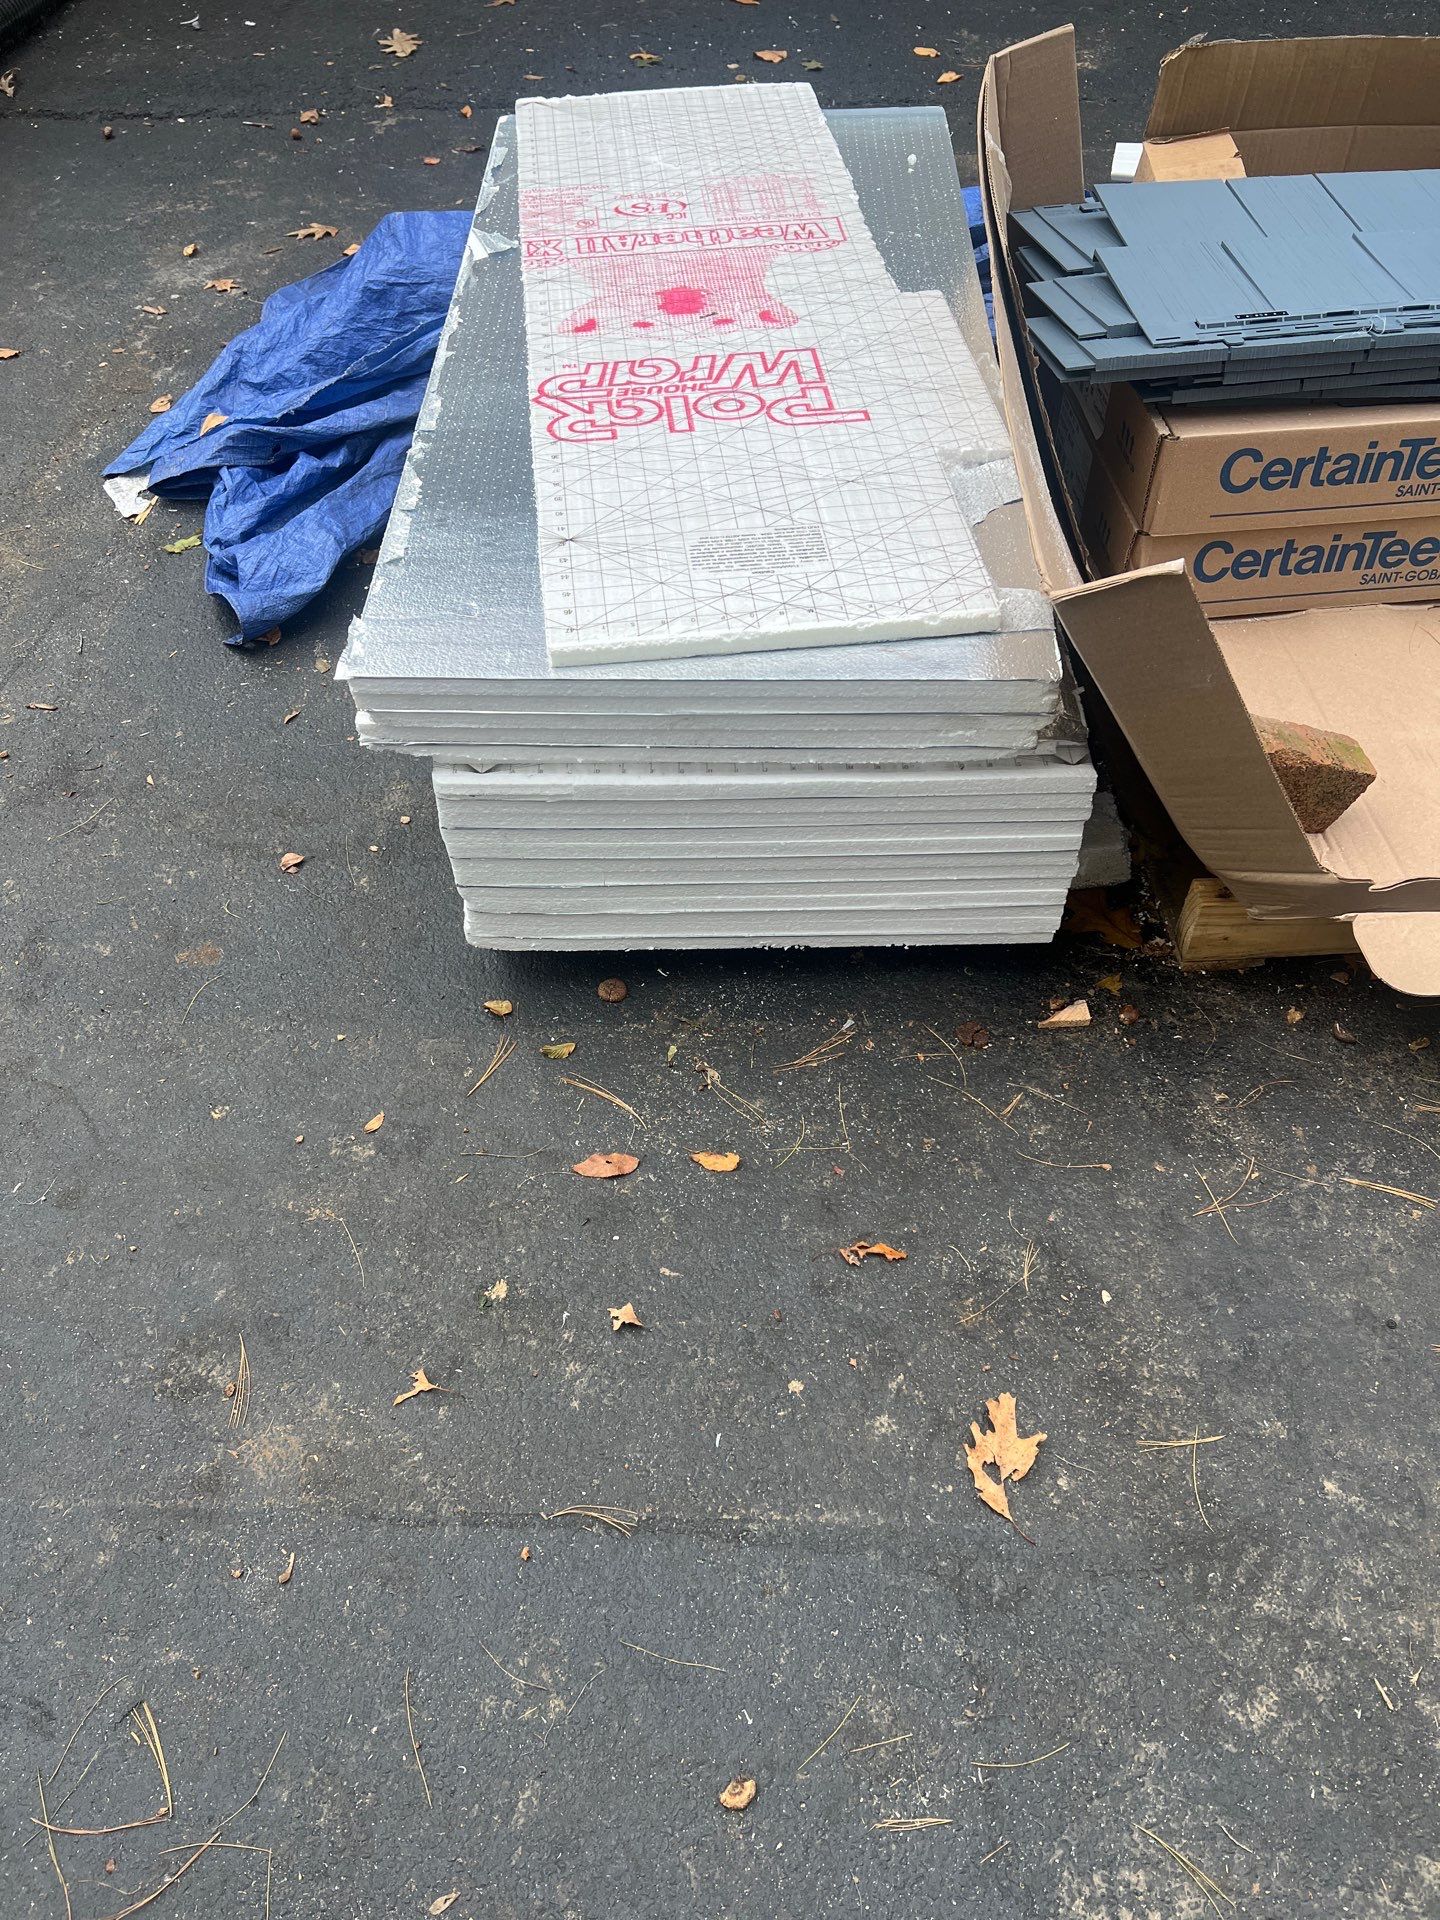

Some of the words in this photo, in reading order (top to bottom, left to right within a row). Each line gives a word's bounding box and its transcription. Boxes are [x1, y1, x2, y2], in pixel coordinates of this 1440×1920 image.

[616, 383, 697, 396] HOUSE
[1219, 438, 1440, 494] CertainTe
[1193, 531, 1440, 584] CertainTee
[1359, 569, 1440, 585] SAINT-GOB
